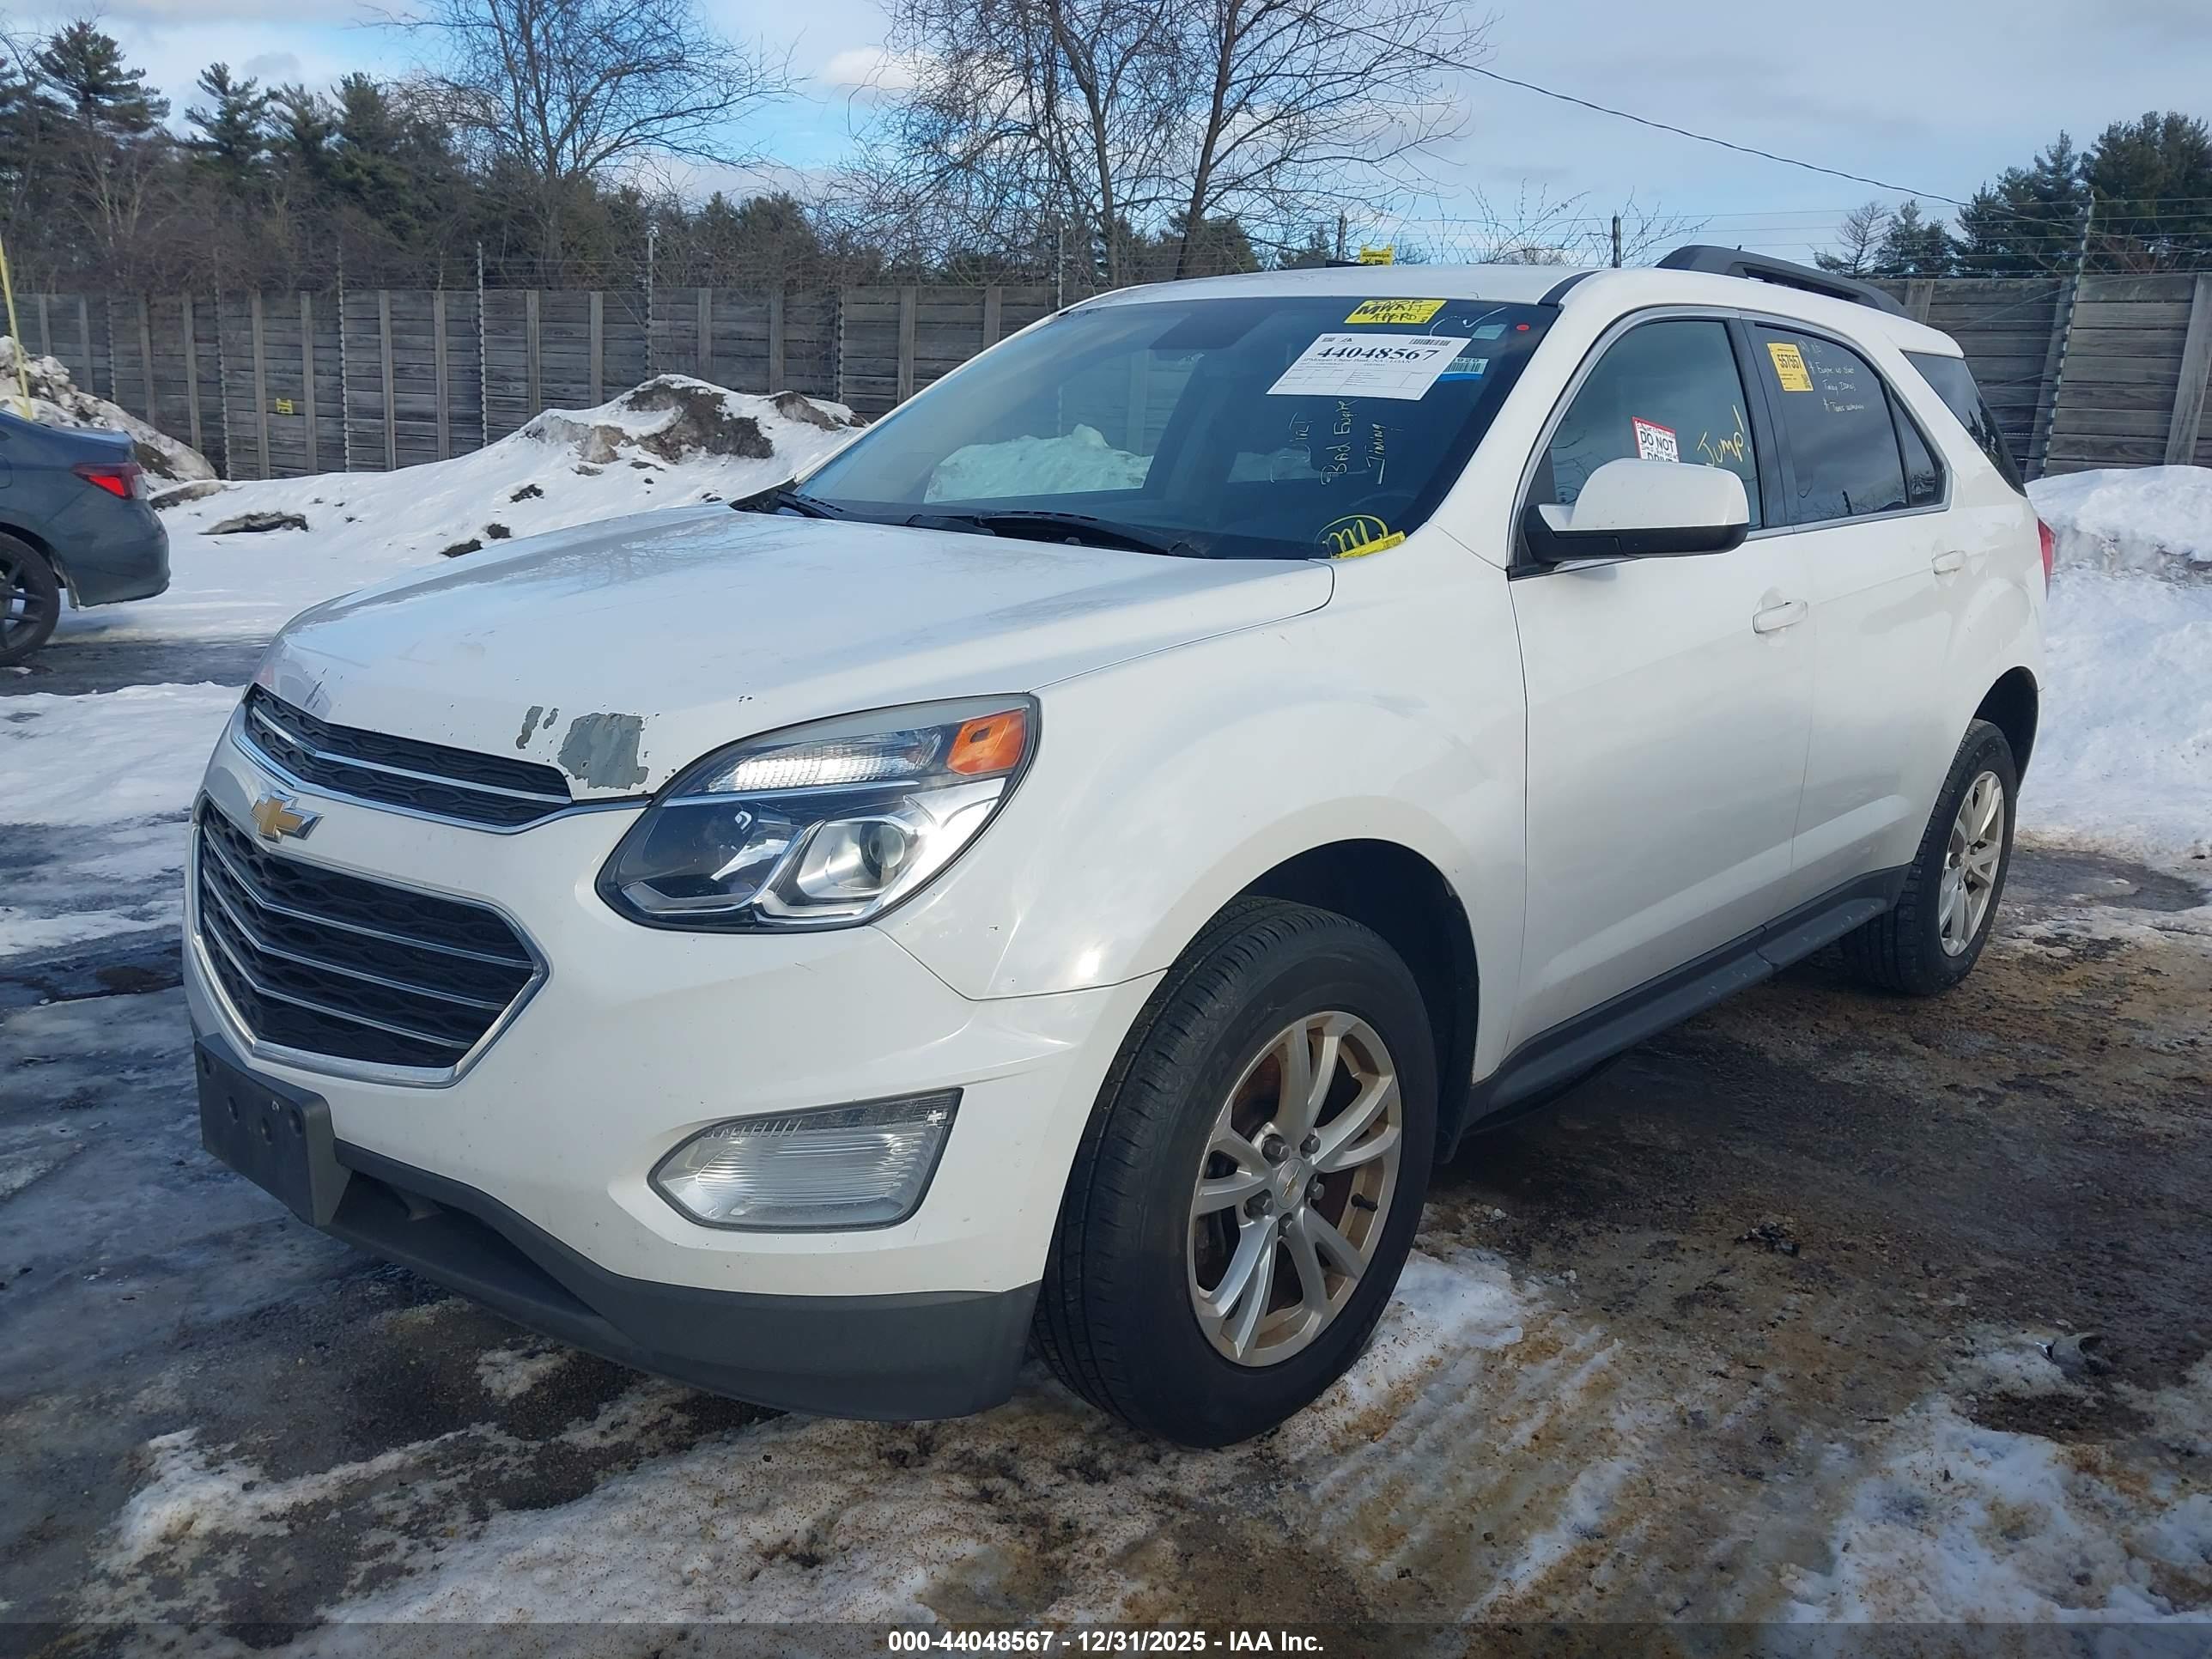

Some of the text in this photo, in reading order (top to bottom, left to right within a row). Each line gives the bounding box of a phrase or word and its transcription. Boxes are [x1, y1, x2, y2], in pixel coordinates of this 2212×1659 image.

[1317, 346, 1441, 362] 44048567
[1640, 430, 1655, 447] DO
[1656, 435, 1674, 453] NOT
[1697, 404, 1751, 468] Jump!
